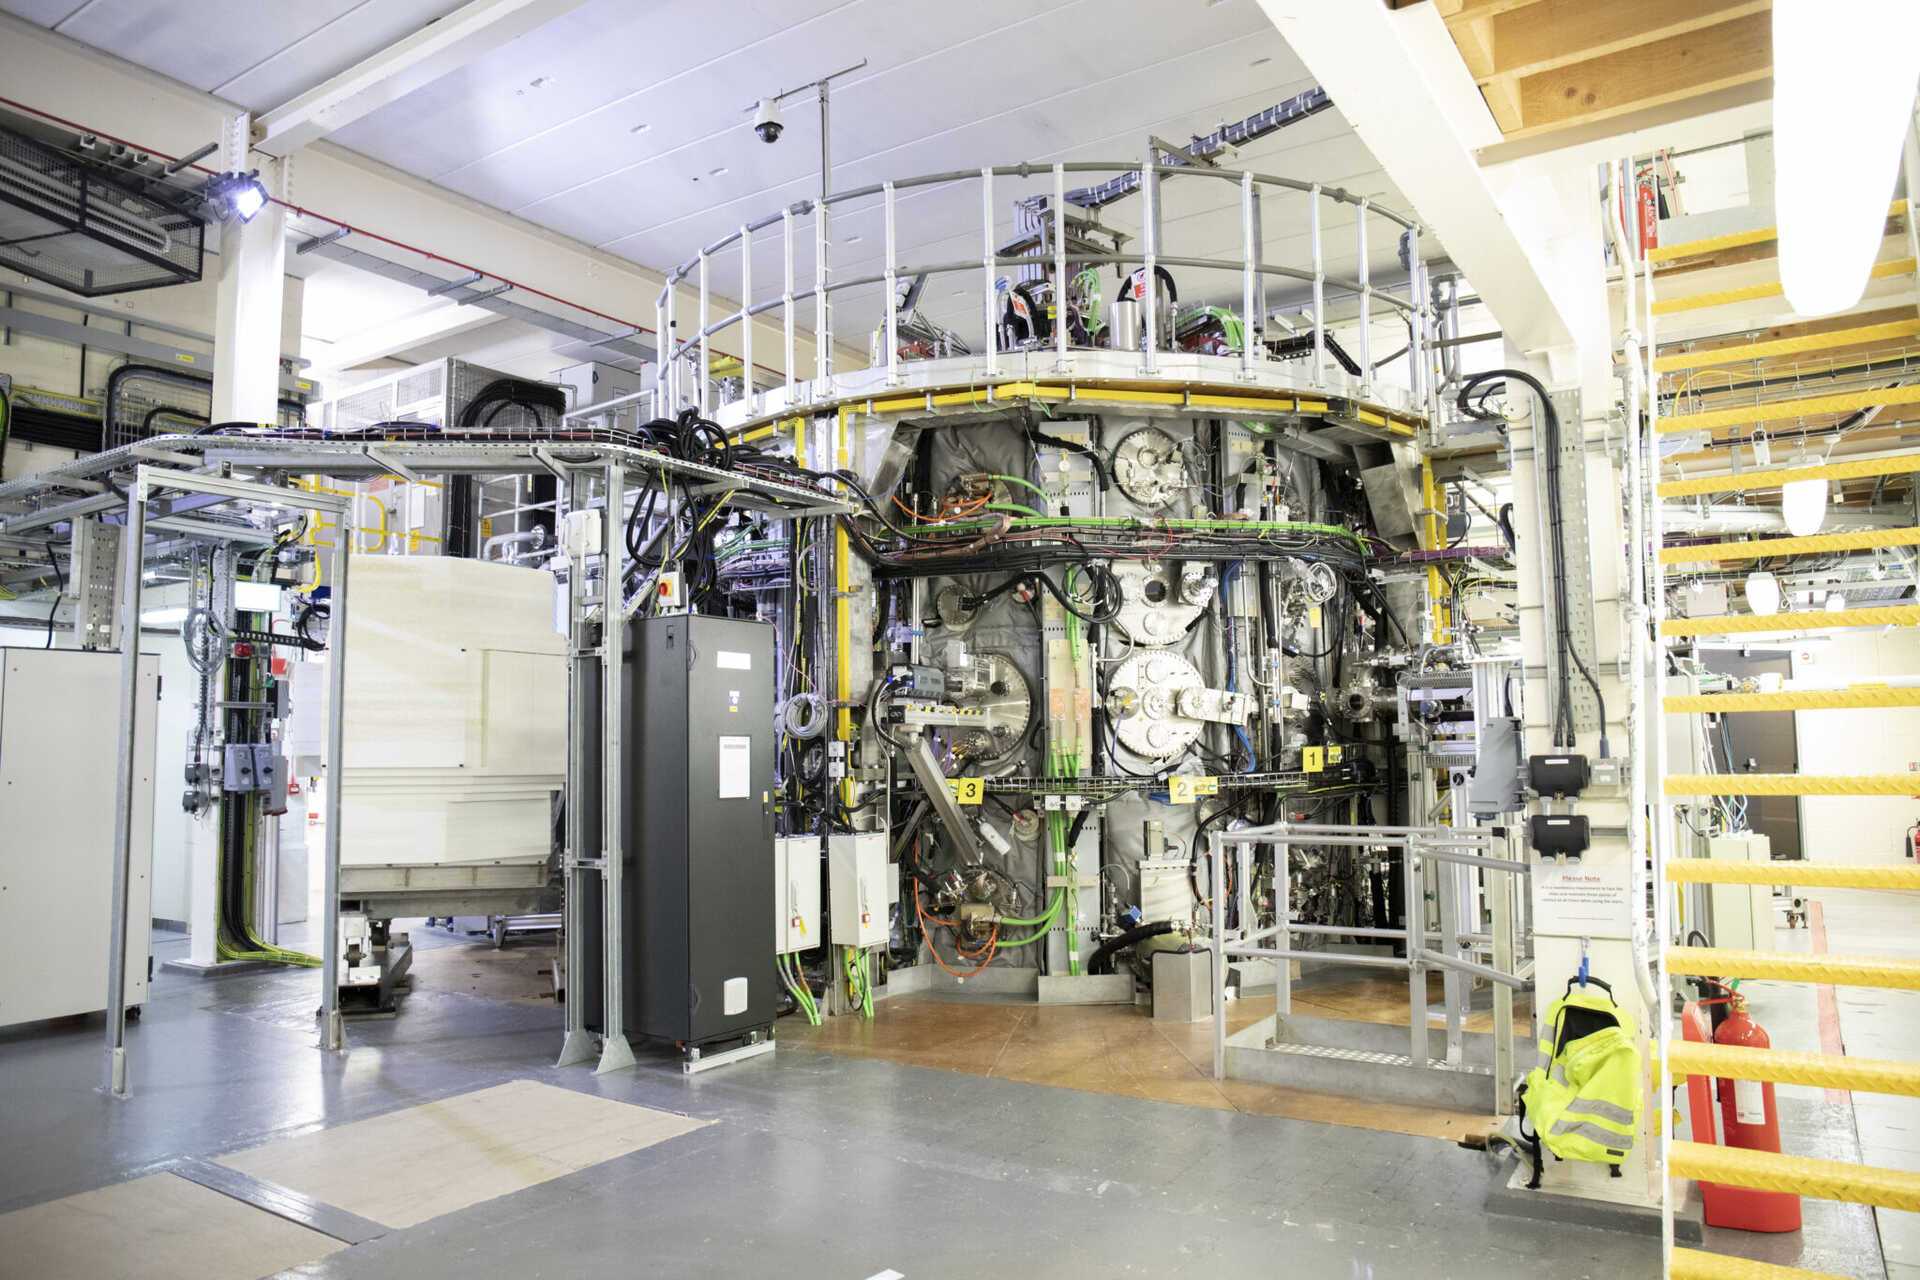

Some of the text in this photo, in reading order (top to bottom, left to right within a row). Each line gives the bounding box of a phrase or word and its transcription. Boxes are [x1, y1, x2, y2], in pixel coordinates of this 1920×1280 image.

[1309, 752, 1315, 766] 1
[966, 783, 976, 797] 3
[1177, 782, 1188, 797] 2
